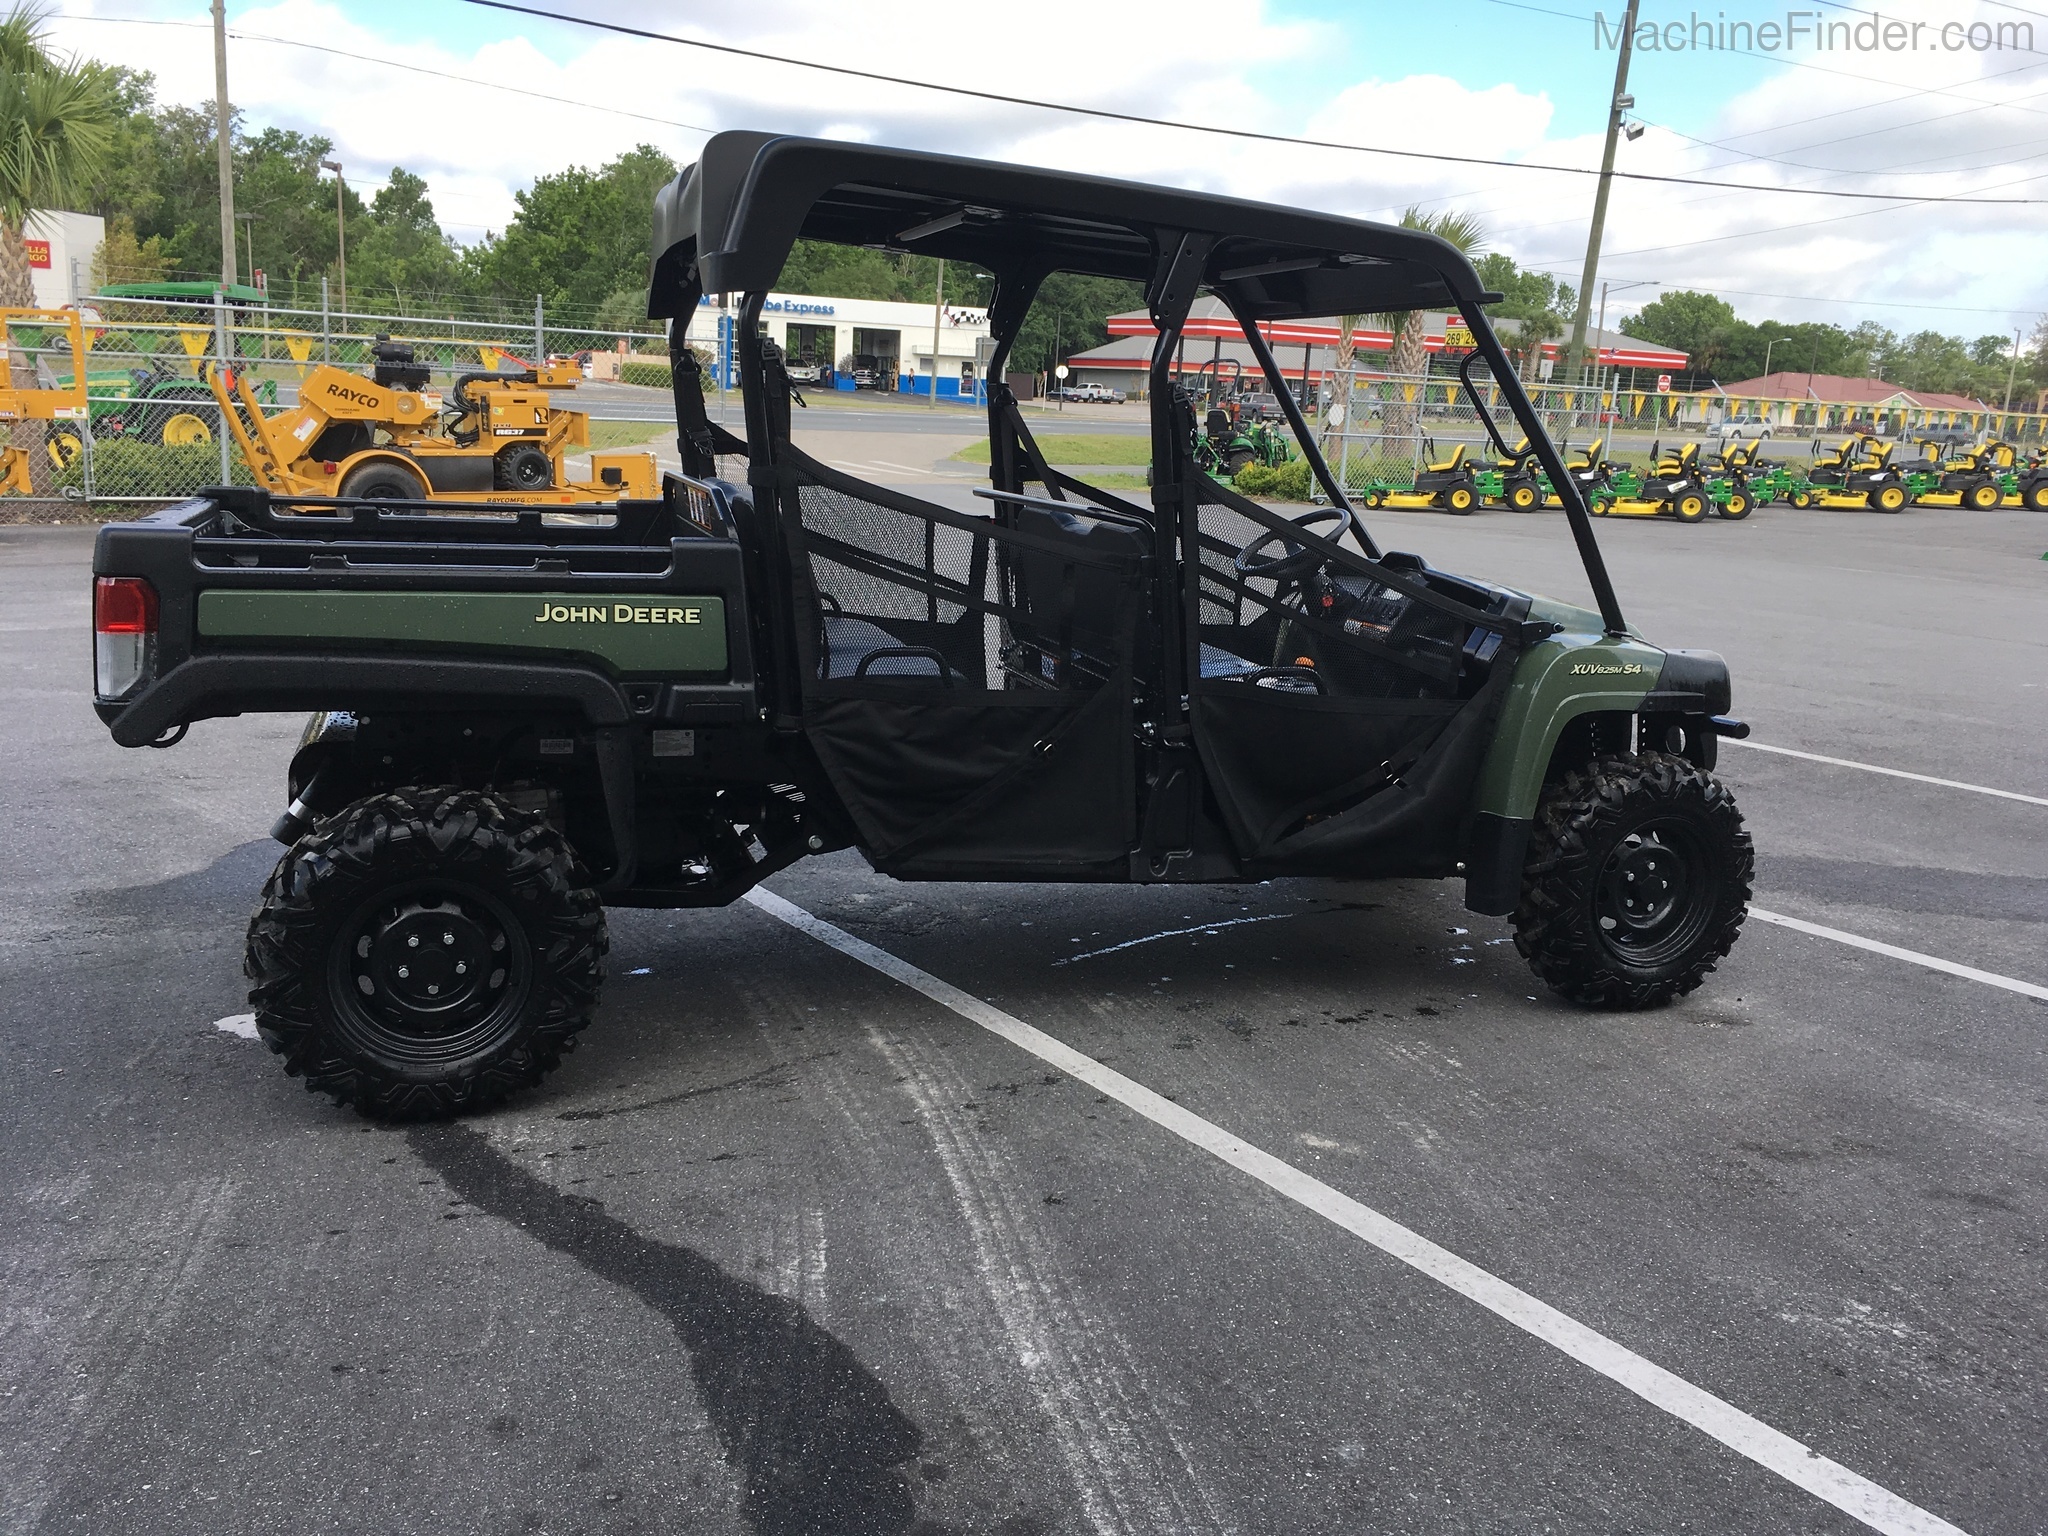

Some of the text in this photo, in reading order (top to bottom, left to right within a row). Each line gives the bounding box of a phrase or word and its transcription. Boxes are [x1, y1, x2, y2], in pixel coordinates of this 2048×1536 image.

[28, 246, 48, 254] LLS
[28, 254, 48, 262] RGO
[784, 300, 834, 315] Express
[326, 383, 379, 408] RAYCO
[535, 603, 701, 624] JOHN DEERE
[1569, 663, 1642, 675] XUV825M S4
